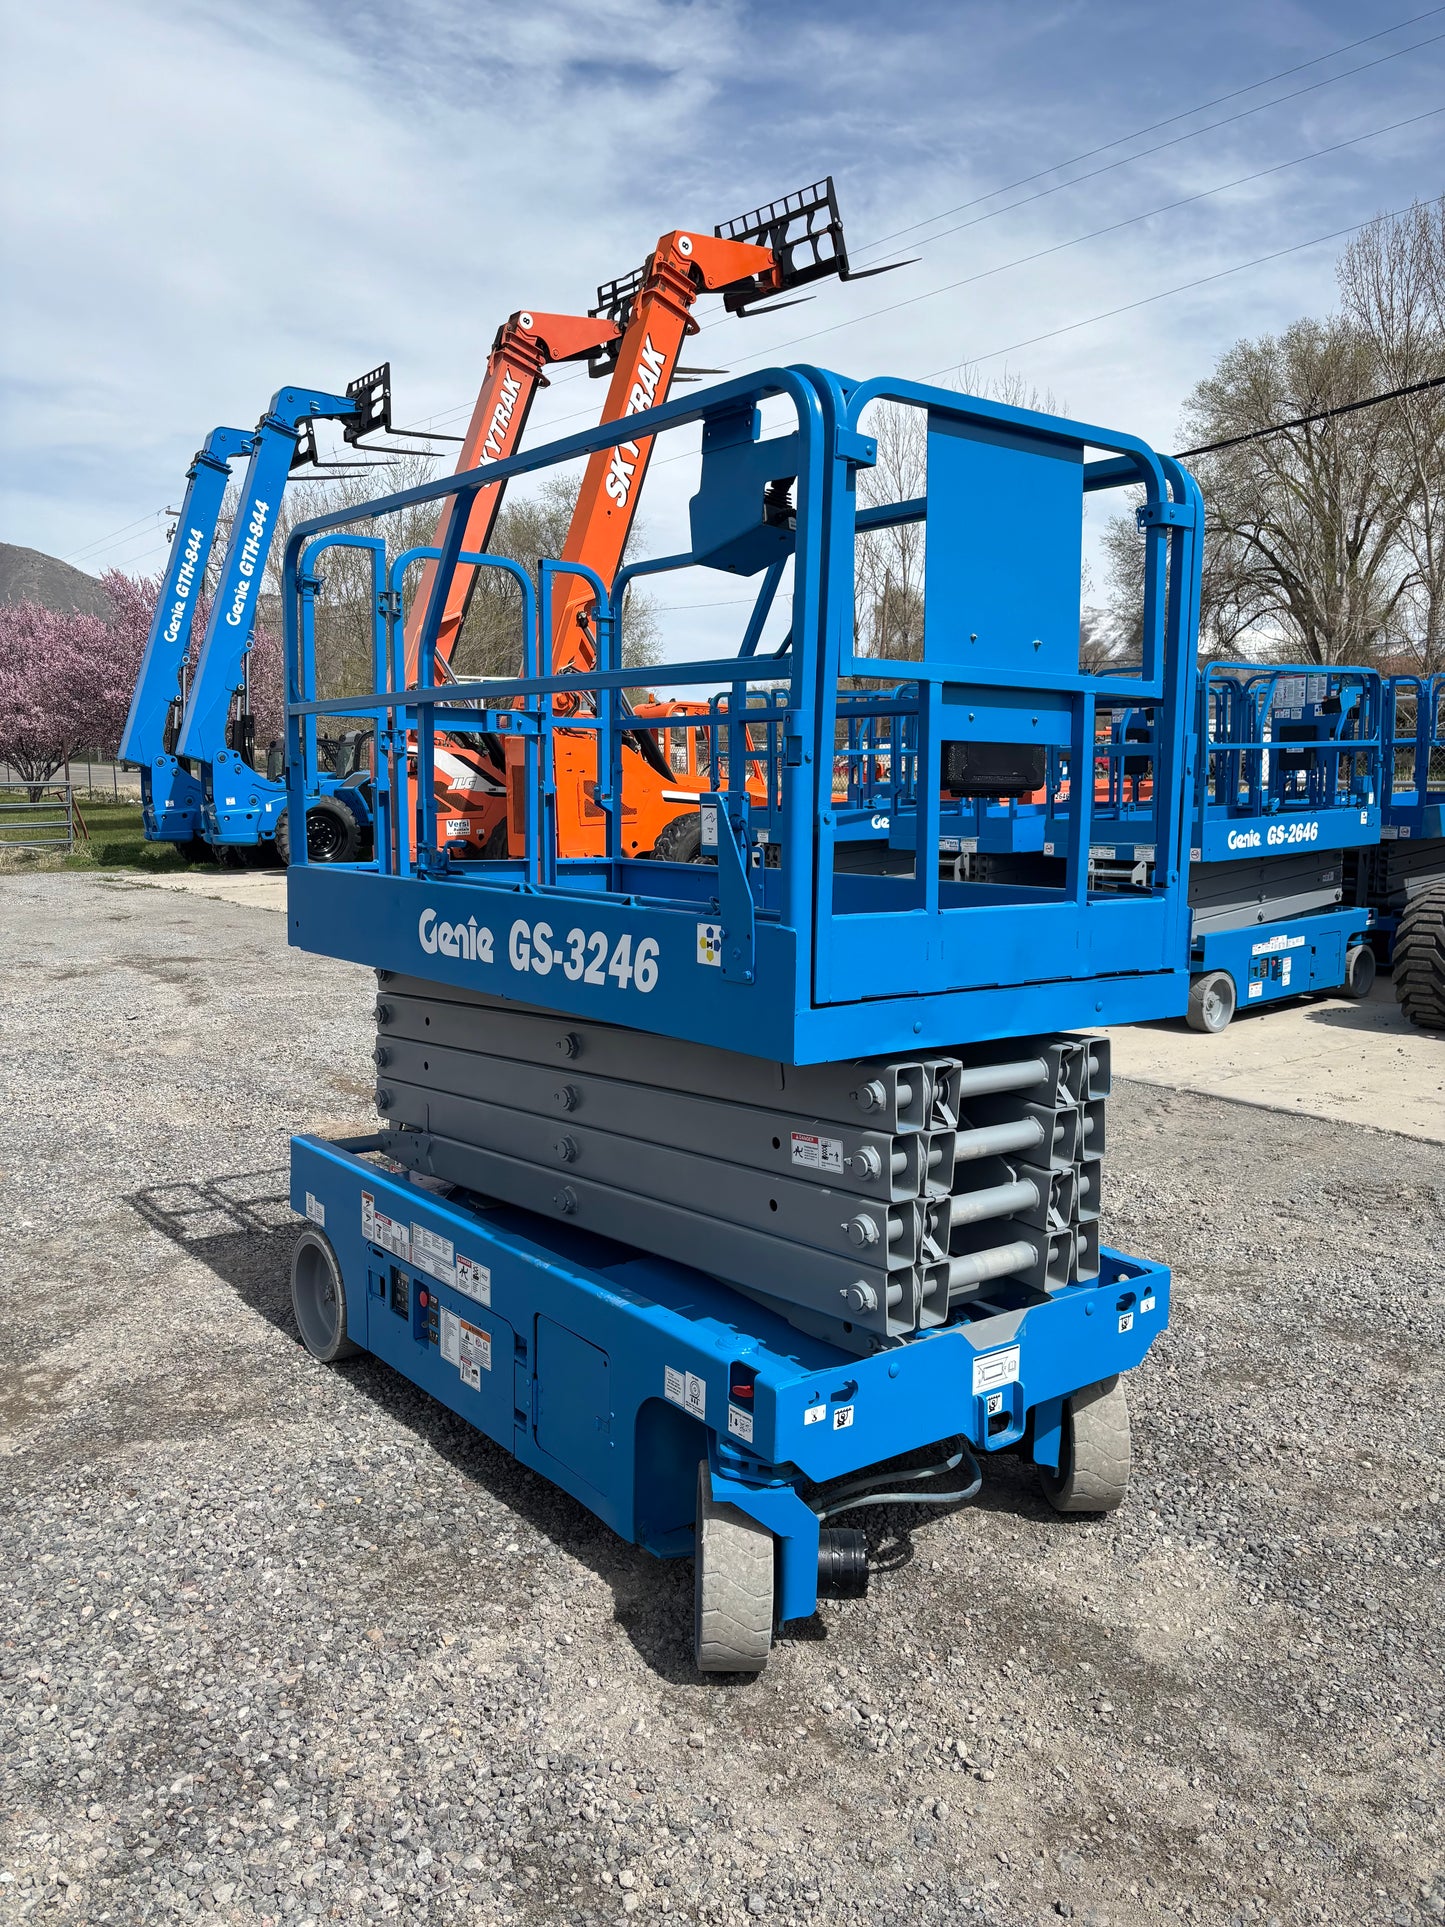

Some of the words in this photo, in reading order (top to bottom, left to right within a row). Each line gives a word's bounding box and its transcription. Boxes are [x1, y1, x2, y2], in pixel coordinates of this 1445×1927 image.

[477, 367, 523, 488] KYTRAK
[605, 332, 667, 509] SKRAK
[163, 600, 187, 643] Genie
[175, 527, 205, 598] GTH-844
[226, 580, 251, 626] Genie
[239, 499, 270, 577] GTH-844
[447, 776, 478, 790] JLG
[1227, 829, 1262, 850] Genie
[1267, 821, 1319, 845] GS-2646
[418, 907, 495, 964] Genie
[508, 918, 661, 993] GS-3246
